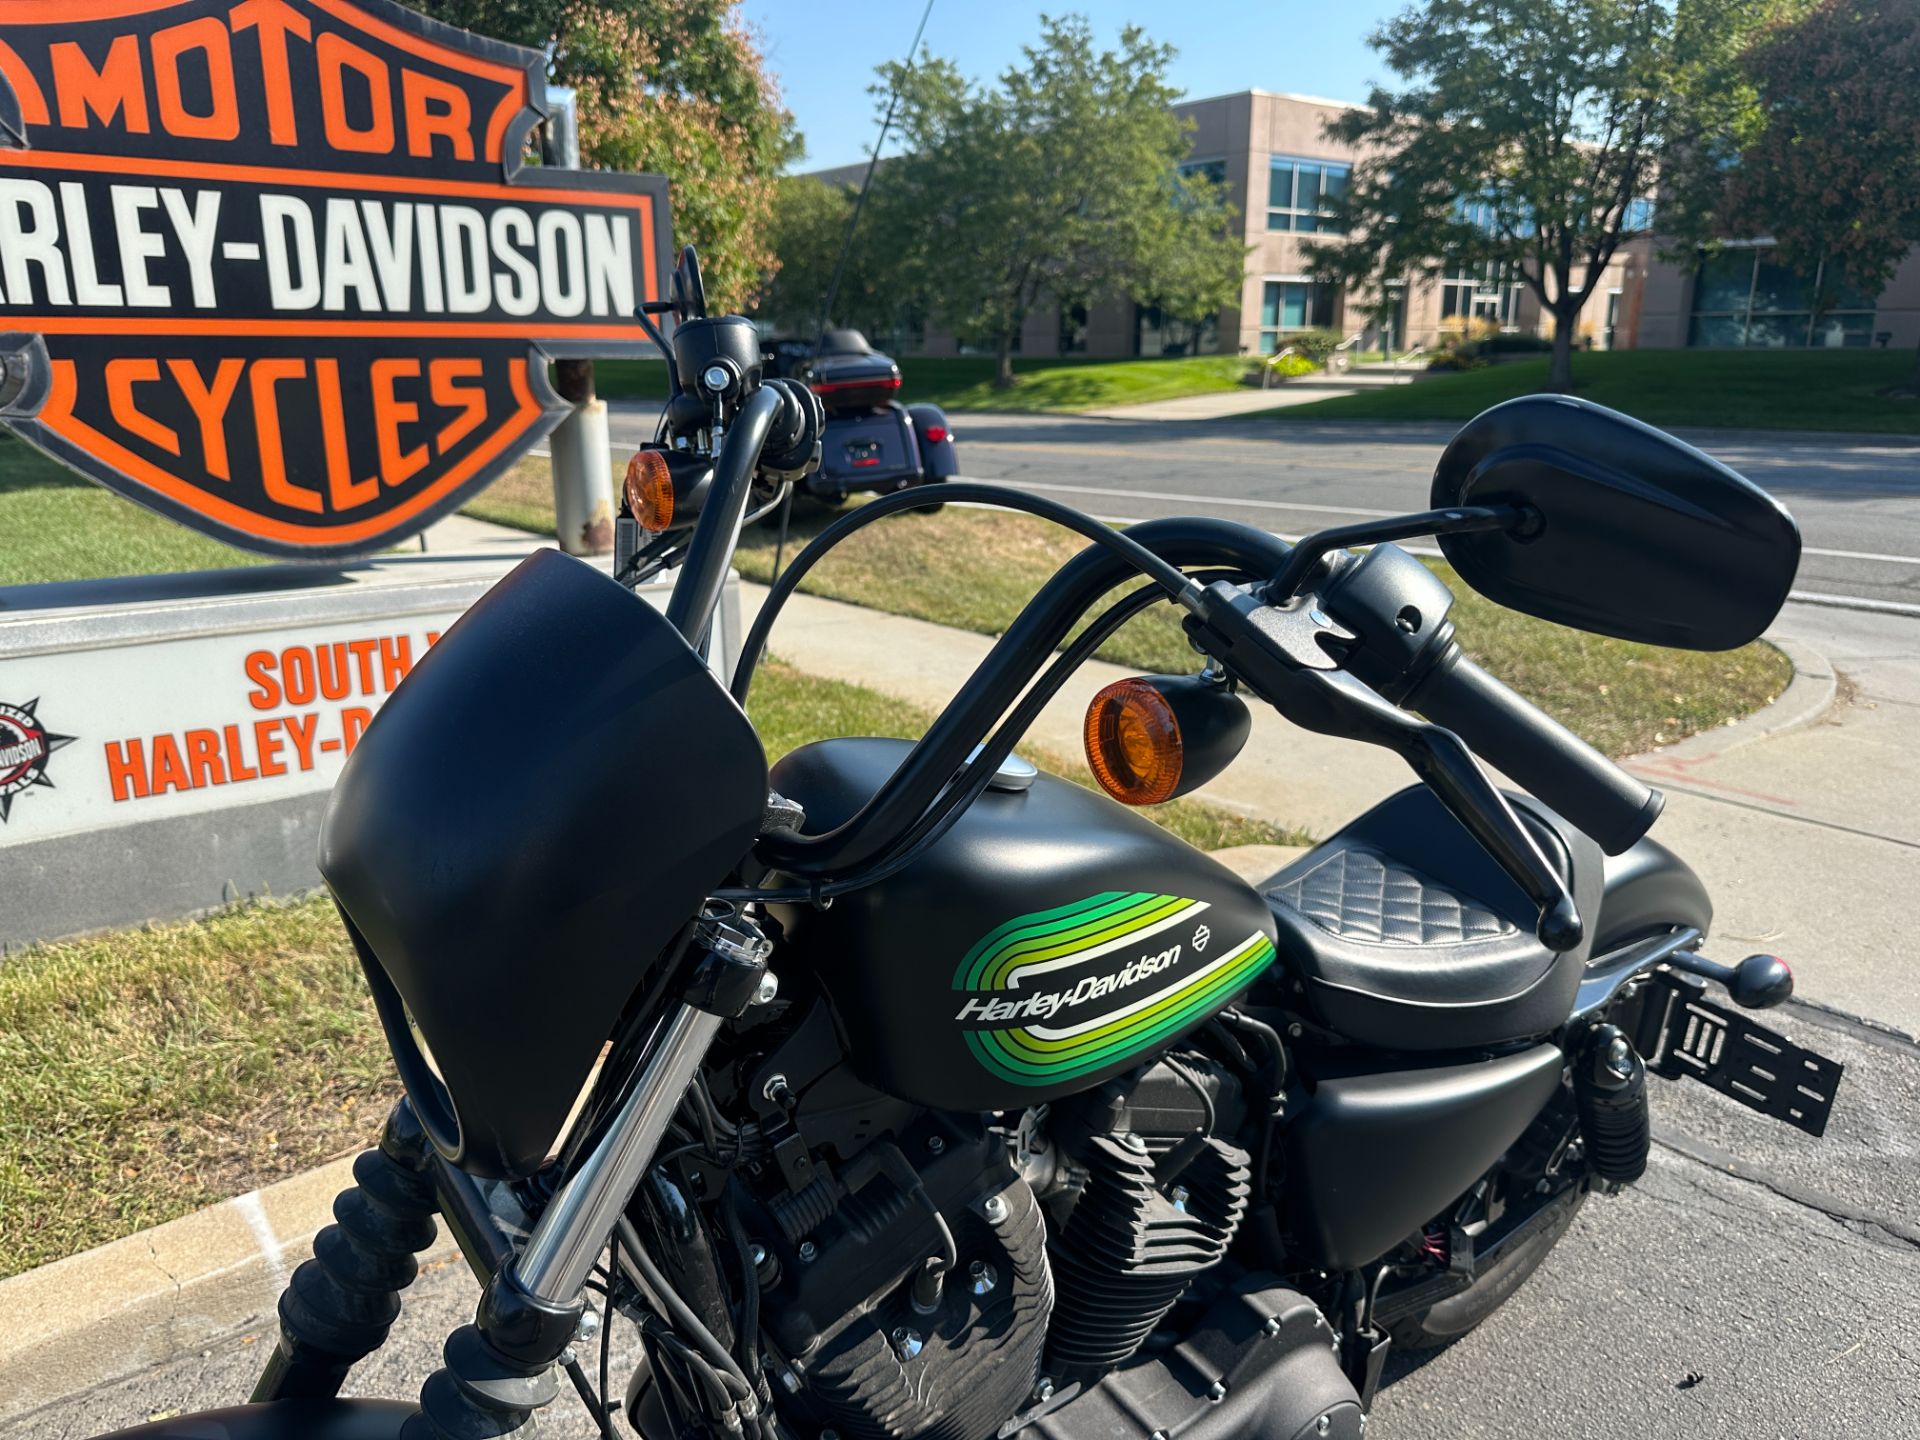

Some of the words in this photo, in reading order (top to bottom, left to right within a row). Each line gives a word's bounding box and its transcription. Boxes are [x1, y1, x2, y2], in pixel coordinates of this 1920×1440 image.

[49, 0, 475, 162] MOTOR
[0, 177, 634, 317] RLEY-DAVIDSON
[105, 358, 488, 514] CYCLES
[0, 704, 35, 728] IZED
[245, 634, 413, 710] SOUTH
[104, 706, 373, 801] HARLEY-D
[955, 944, 1181, 1021] Harley-Davidson
